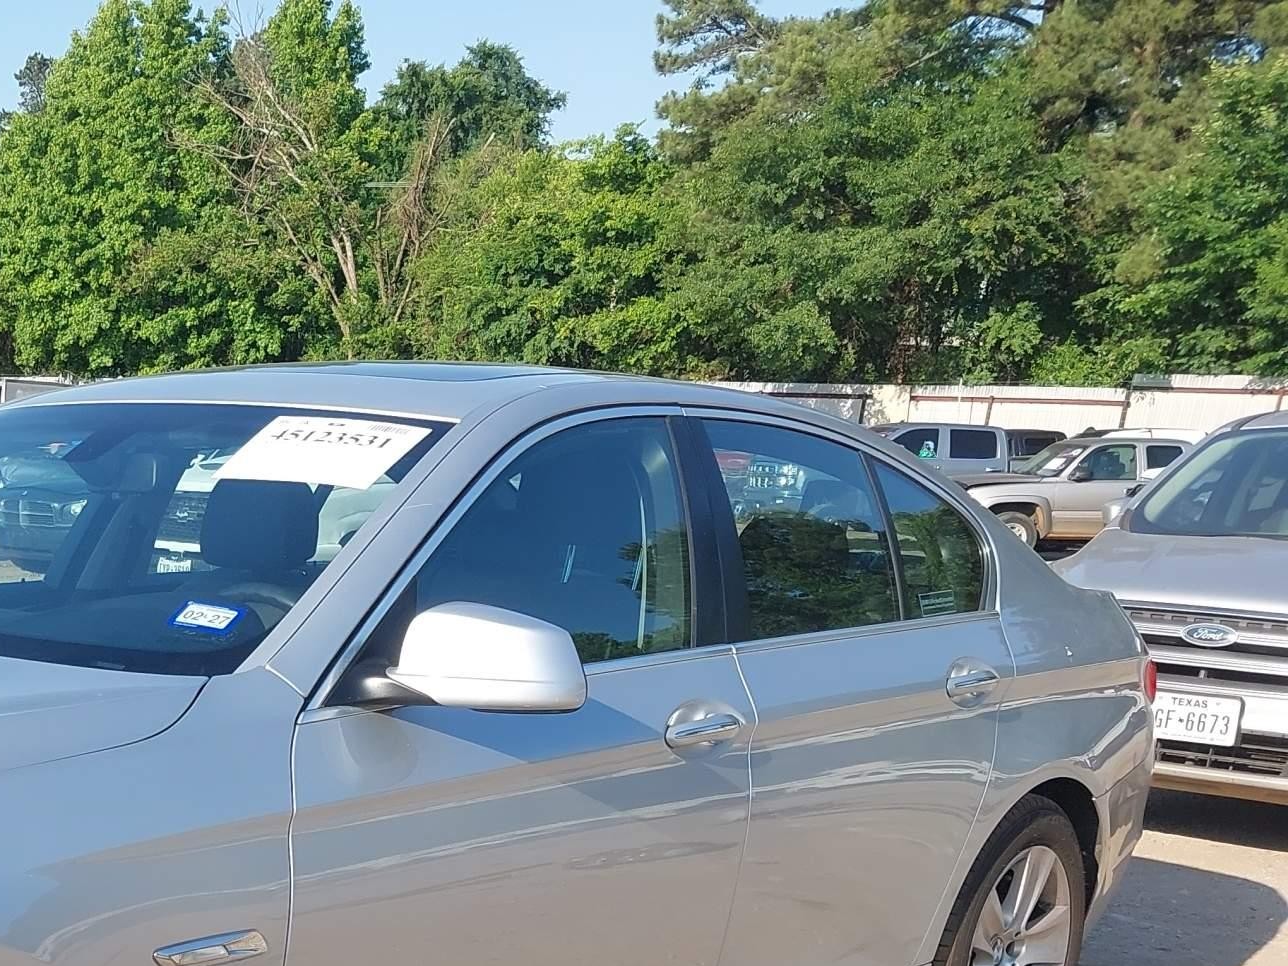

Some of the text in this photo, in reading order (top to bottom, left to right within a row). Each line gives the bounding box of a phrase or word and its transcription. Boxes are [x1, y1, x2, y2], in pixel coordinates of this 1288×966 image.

[271, 429, 393, 449] 45123531
[1192, 626, 1224, 641] Ford
[1170, 696, 1209, 709] TEXAS
